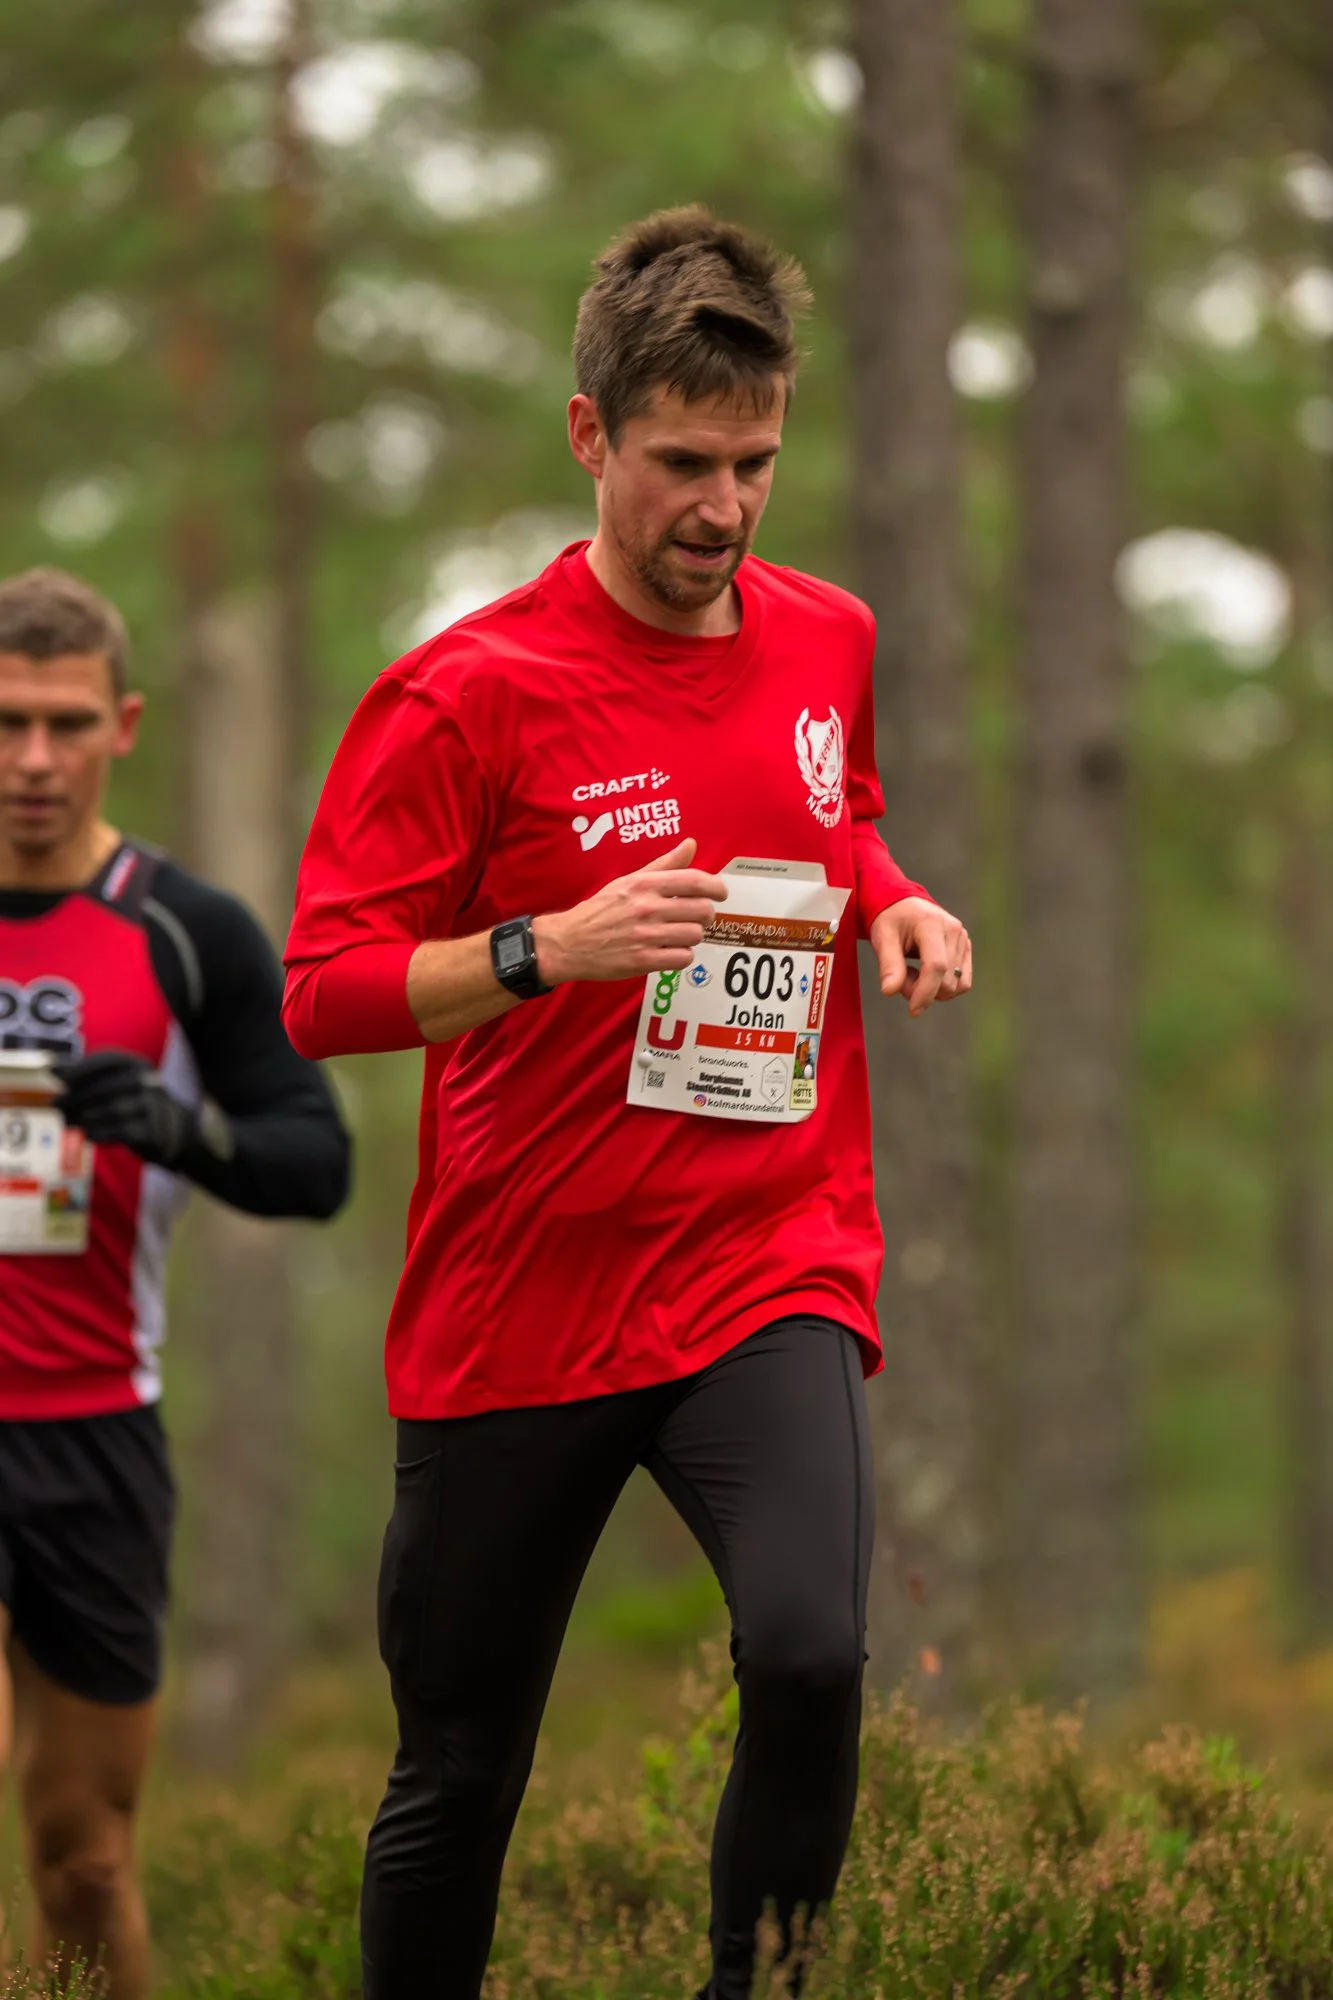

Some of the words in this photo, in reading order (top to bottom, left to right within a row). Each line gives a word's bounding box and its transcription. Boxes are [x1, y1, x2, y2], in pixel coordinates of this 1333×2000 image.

[572, 773, 649, 801] CRAFT
[615, 799, 680, 826] INTER
[618, 816, 681, 843] SPORT
[724, 952, 794, 1002] 603
[725, 1004, 785, 1029] Johan
[810, 981, 823, 1025] CIRCLE
[735, 1031, 752, 1047] 15
[759, 1033, 776, 1048] KM
